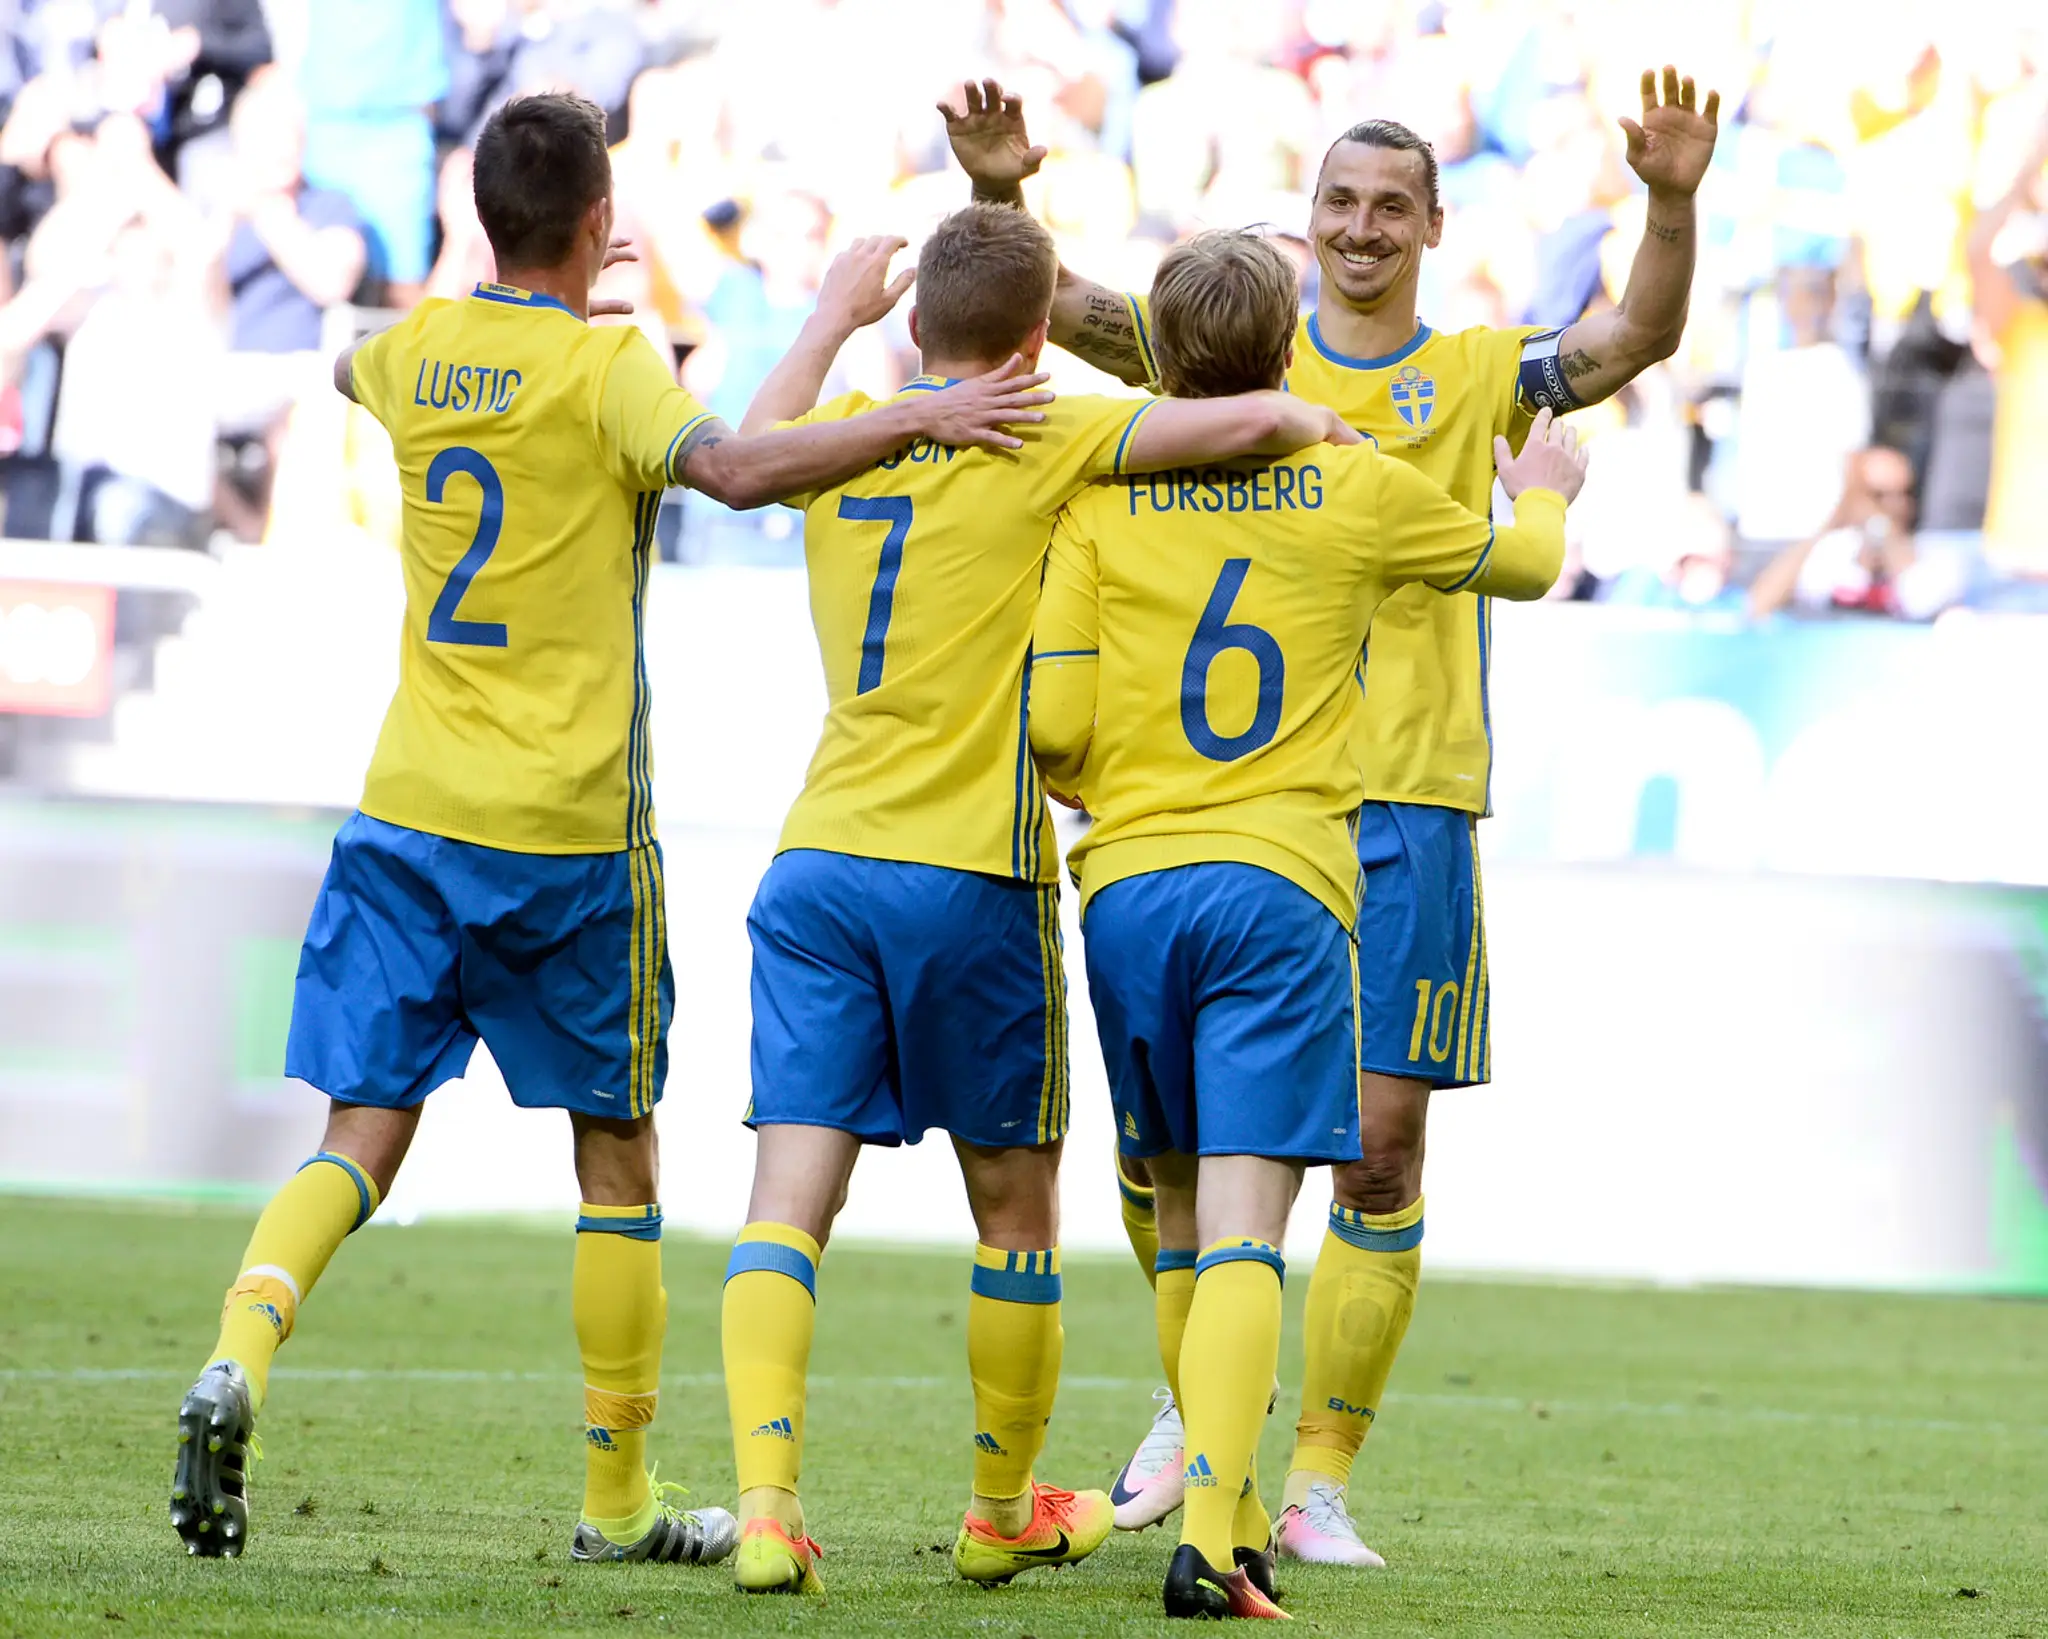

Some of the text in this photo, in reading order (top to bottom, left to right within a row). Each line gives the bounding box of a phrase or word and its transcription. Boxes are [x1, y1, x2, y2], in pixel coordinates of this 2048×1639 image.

[414, 358, 522, 413] LUSTIG
[1543, 357, 1567, 402] RACISM
[1128, 464, 1324, 516] FORSBERG
[426, 446, 508, 647] 2
[838, 495, 913, 696] 7
[1180, 558, 1285, 762] 6
[1408, 979, 1459, 1063] 10
